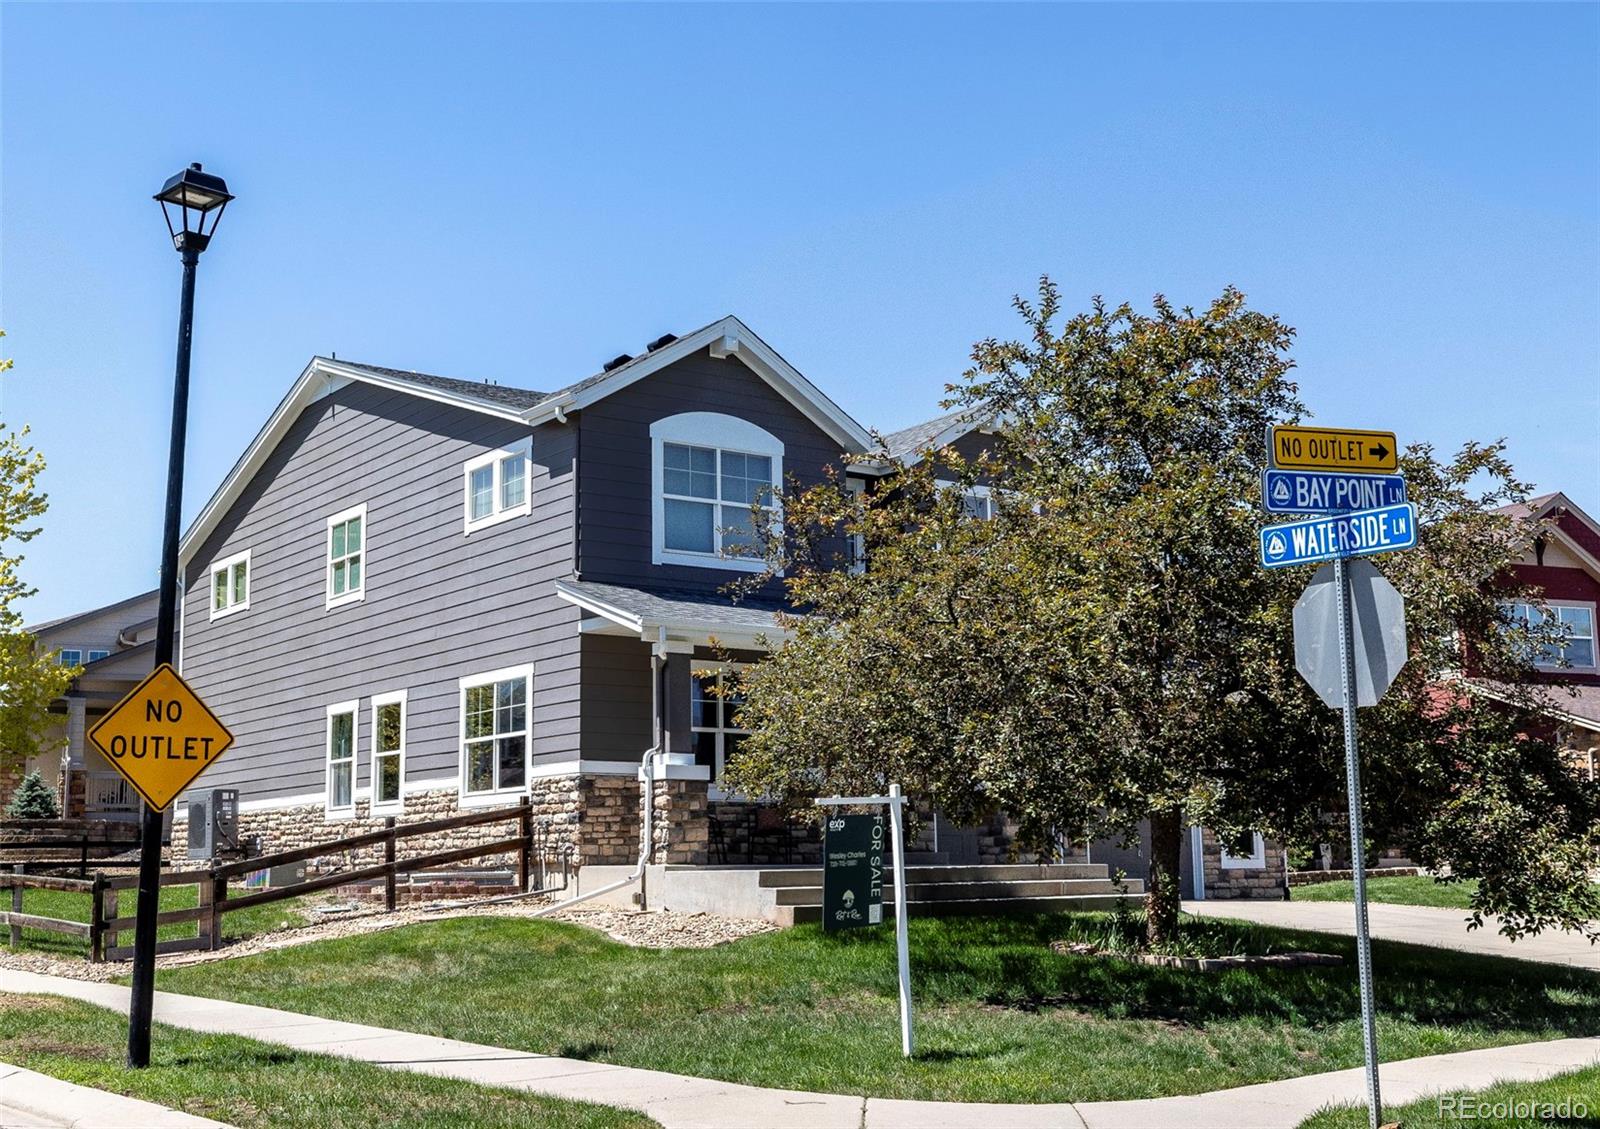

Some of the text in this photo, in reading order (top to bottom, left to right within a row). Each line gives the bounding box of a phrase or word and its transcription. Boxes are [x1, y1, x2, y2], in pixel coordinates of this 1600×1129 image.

[1281, 437, 1364, 461] NO OUTLET
[1296, 477, 1403, 509] BAY POINT LN
[1291, 513, 1406, 557] WATERSIDE LN
[146, 699, 182, 723] NO
[110, 735, 214, 760] OUTLET
[870, 815, 883, 897] FOR SALE
